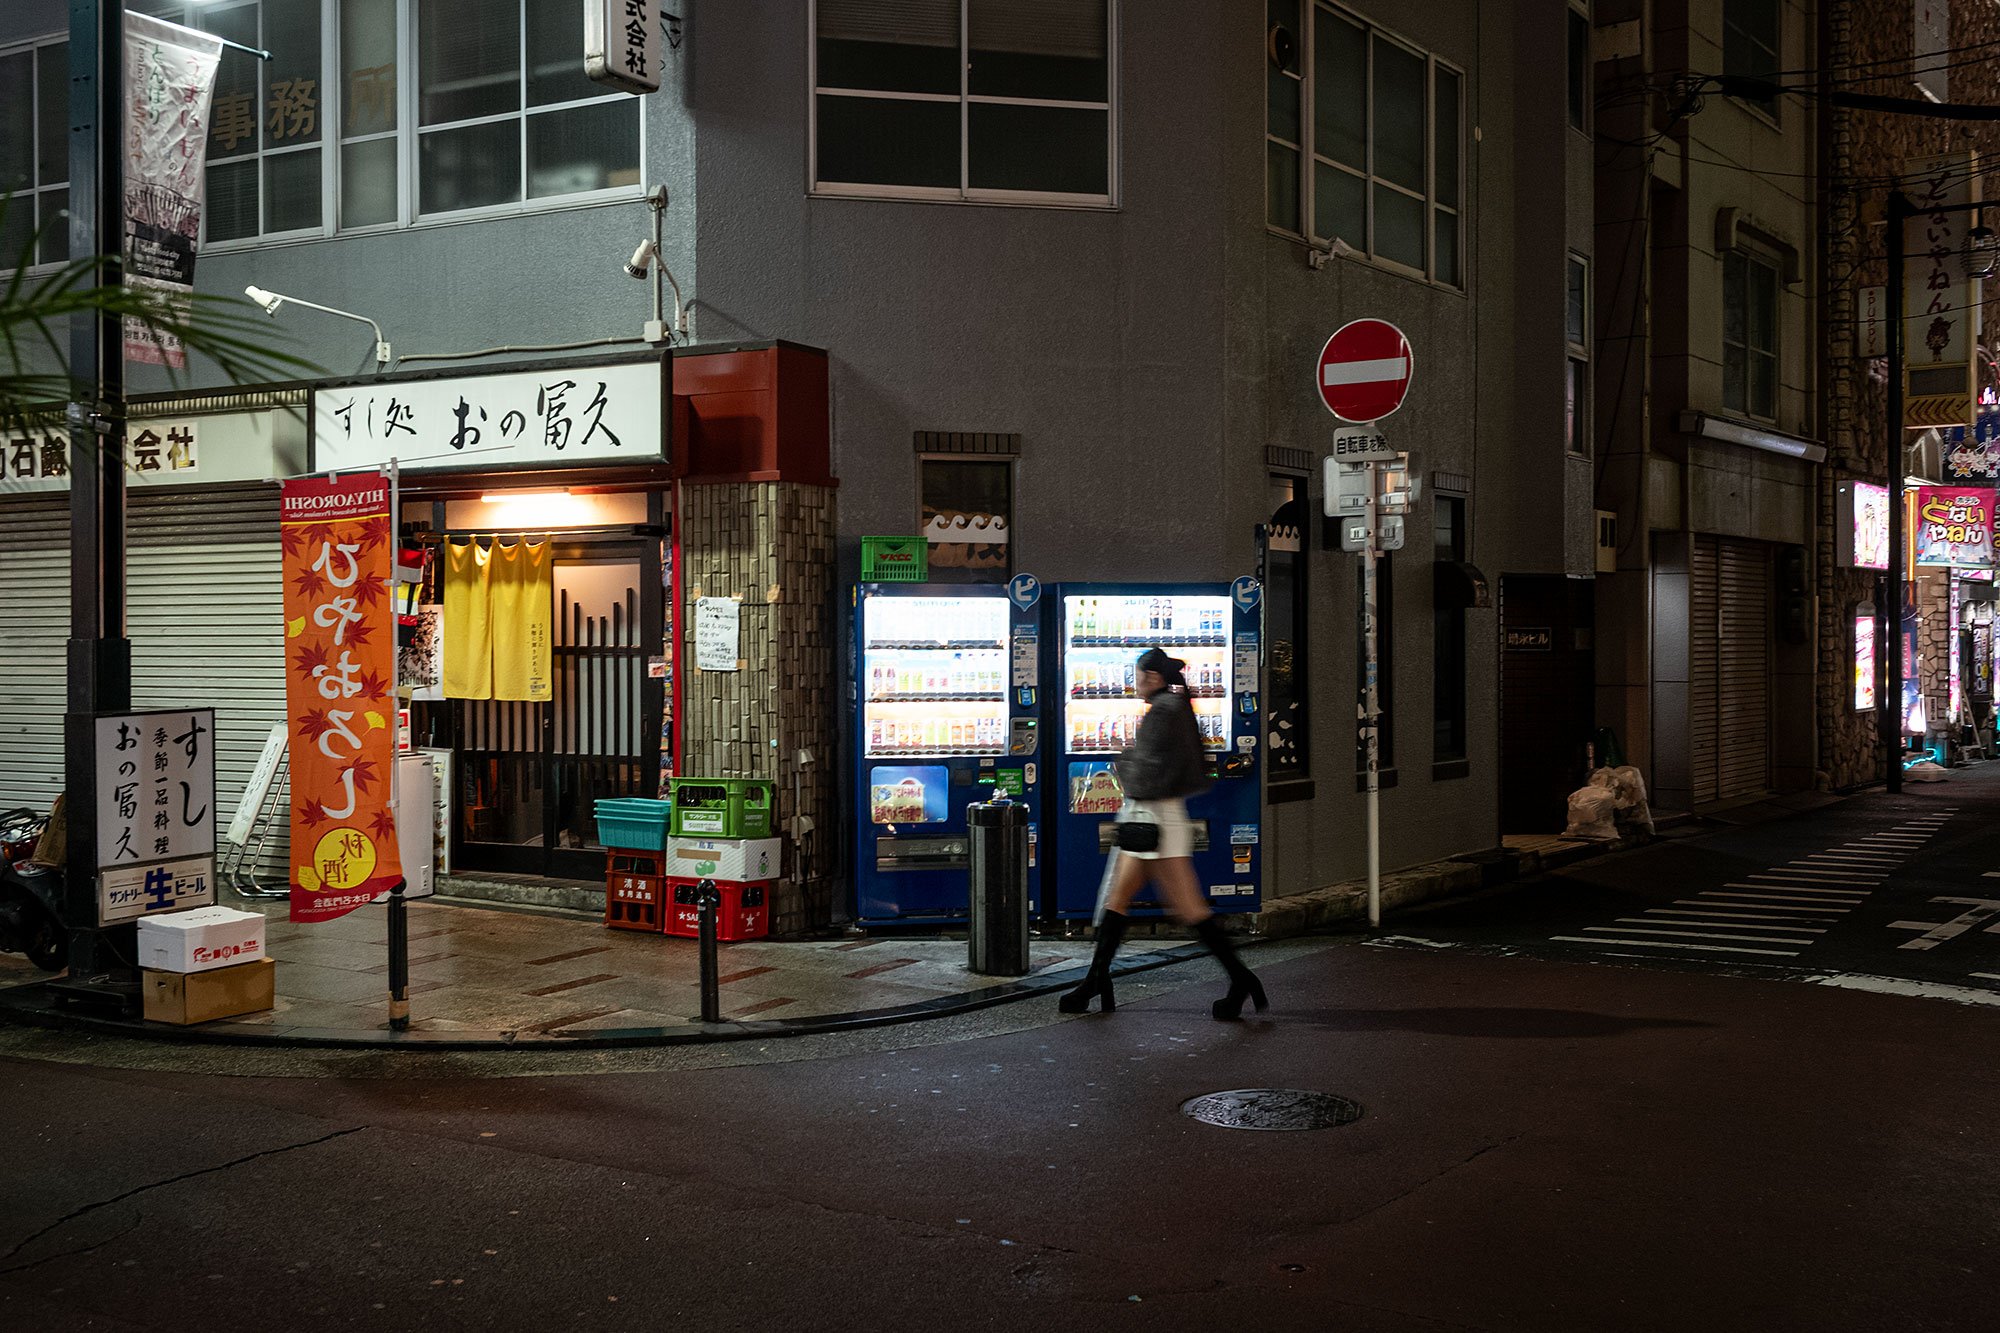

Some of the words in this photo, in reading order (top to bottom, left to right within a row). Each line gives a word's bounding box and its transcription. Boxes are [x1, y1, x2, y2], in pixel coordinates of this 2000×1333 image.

[211, 63, 397, 150] 事務所
[334, 396, 418, 439] すし処
[1337, 434, 1392, 454] 自転車を除
[1921, 494, 1986, 525] どない
[1928, 524, 1984, 545] やねん
[153, 727, 170, 855] 季節一品料理
[173, 716, 207, 827] すし
